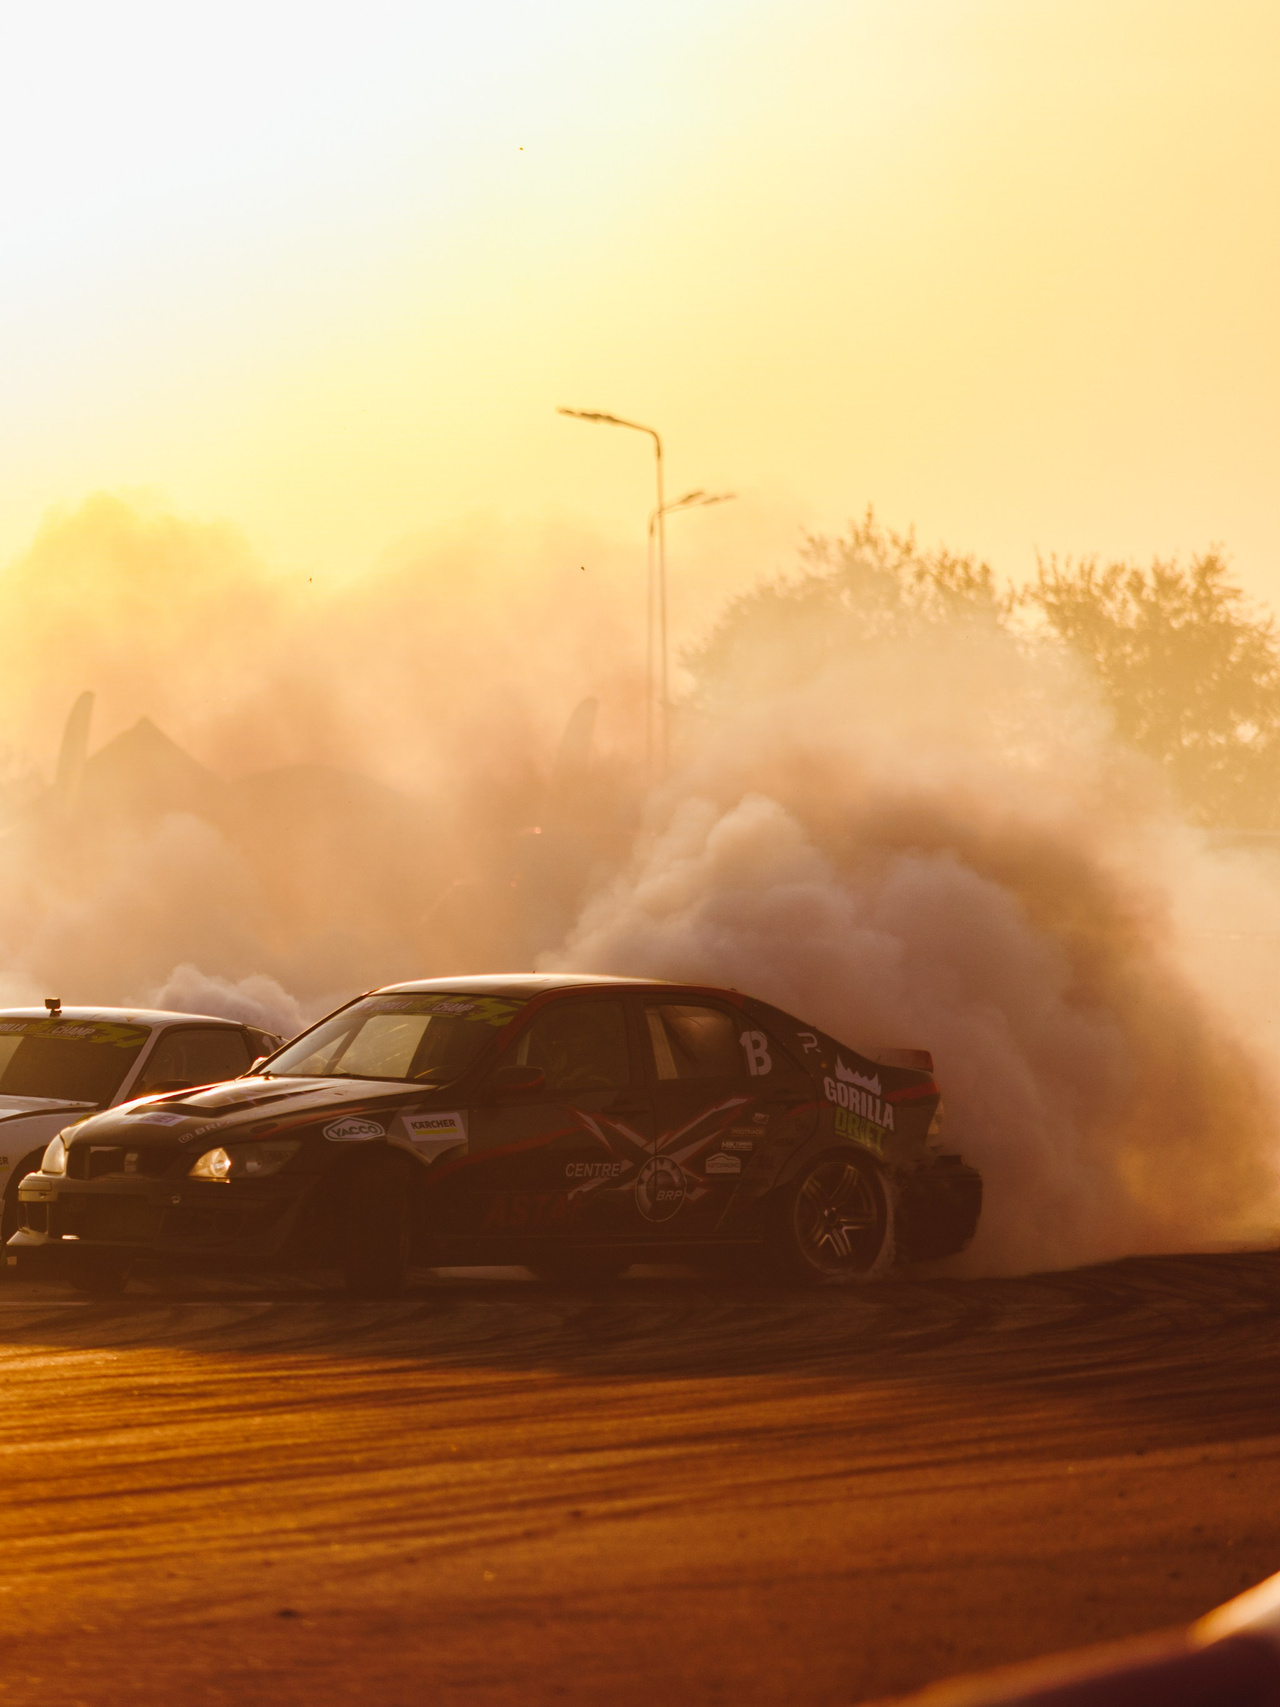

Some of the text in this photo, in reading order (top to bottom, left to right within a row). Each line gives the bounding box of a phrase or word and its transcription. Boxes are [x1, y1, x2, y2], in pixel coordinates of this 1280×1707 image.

[51, 1025, 96, 1036] CHAMP
[823, 1076, 894, 1131] GORILLA
[331, 1125, 378, 1137] YACCO
[565, 1163, 621, 1177] CENTRE
[656, 1190, 683, 1201] BRP
